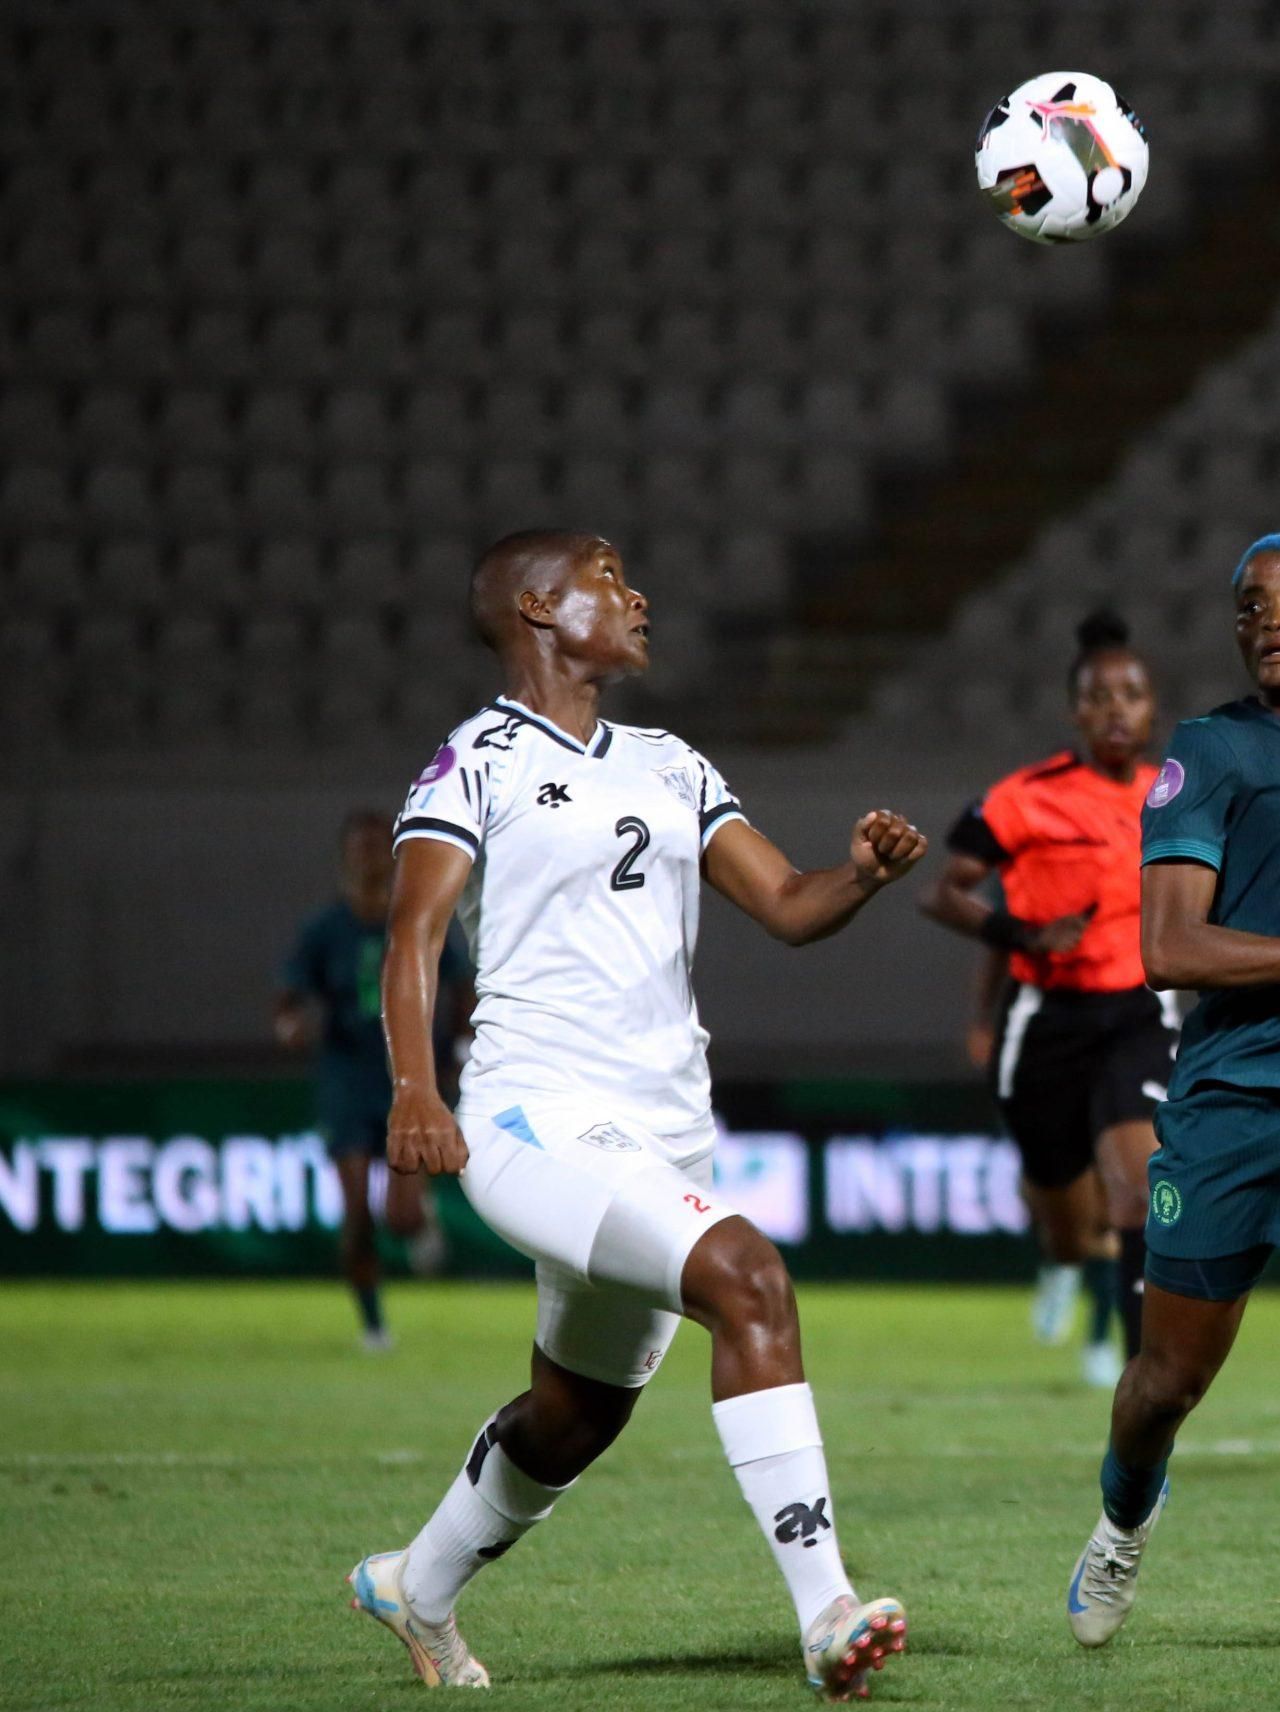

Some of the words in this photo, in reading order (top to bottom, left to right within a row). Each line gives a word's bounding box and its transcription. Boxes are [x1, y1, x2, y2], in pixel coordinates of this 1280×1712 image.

[611, 816, 651, 892] 2
[0, 1136, 389, 1232] NTEGRIT
[683, 1193, 711, 1213] 2
